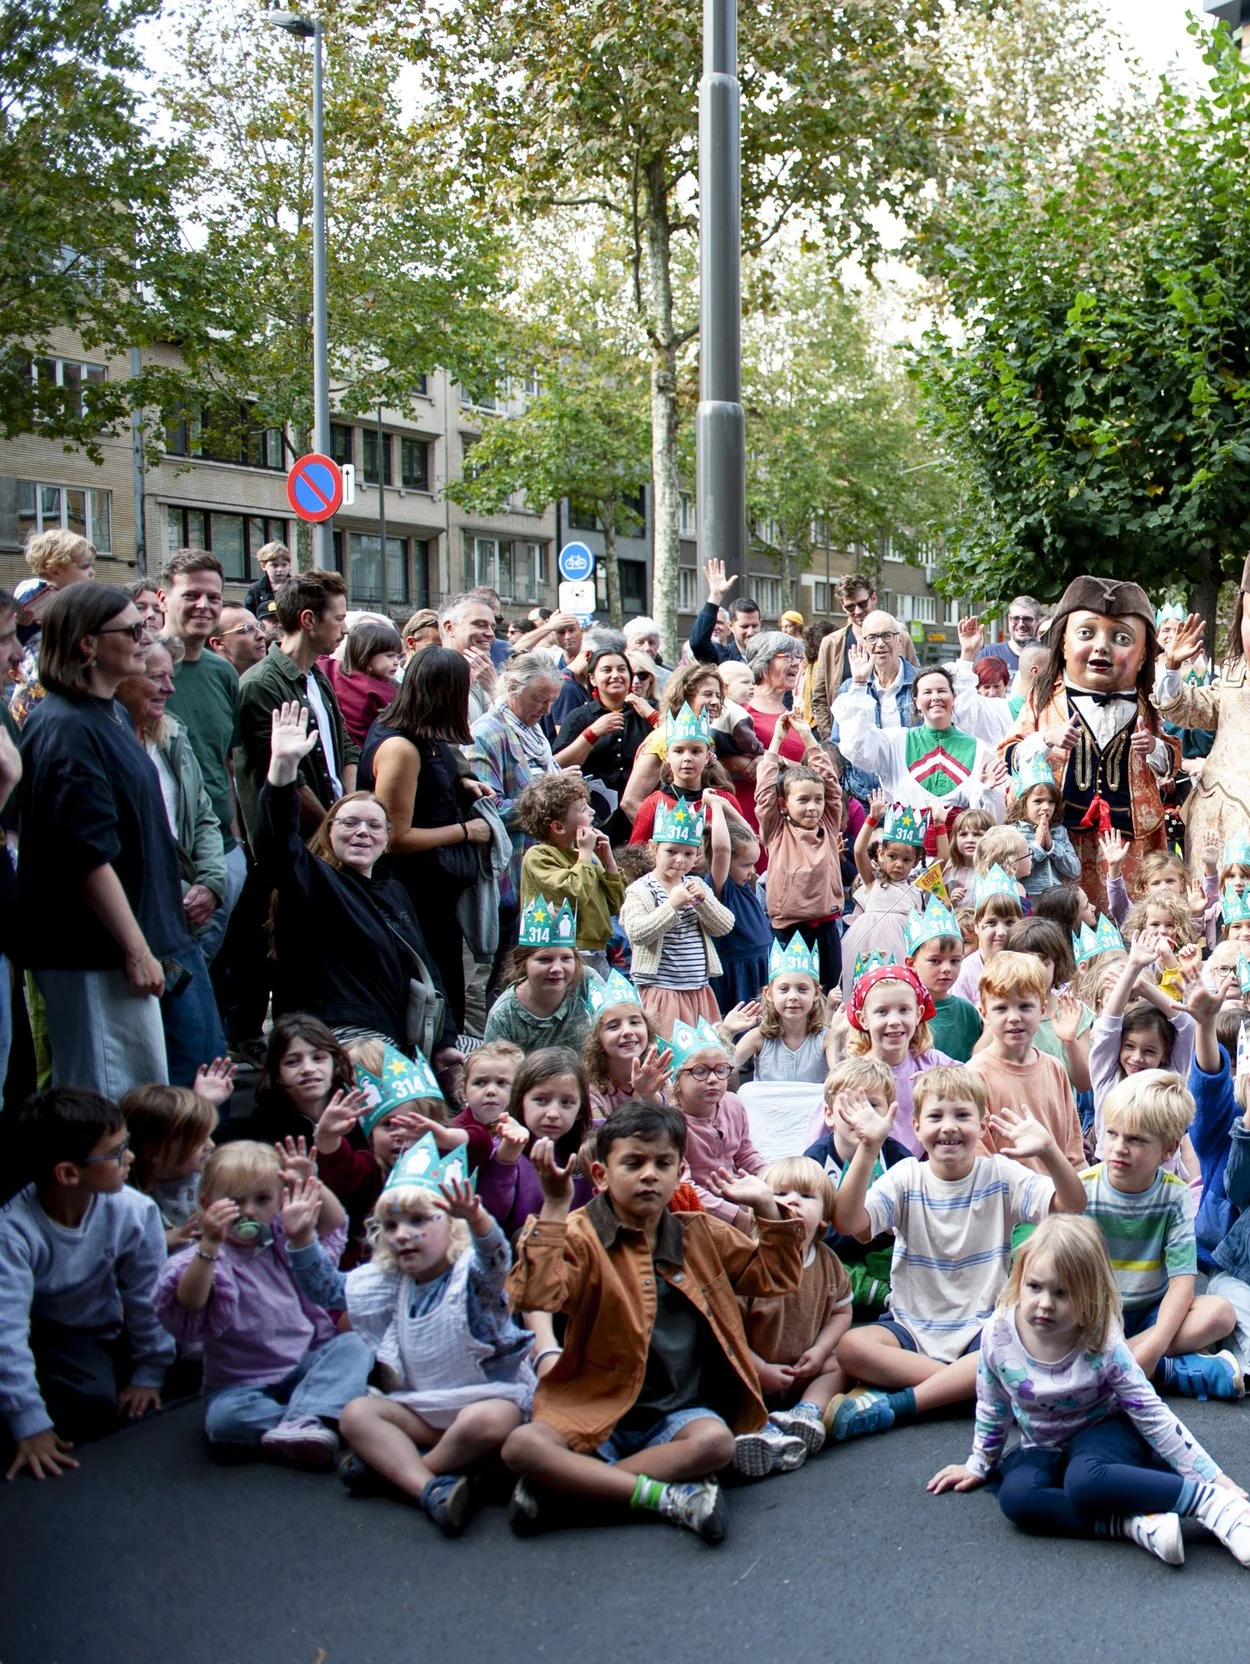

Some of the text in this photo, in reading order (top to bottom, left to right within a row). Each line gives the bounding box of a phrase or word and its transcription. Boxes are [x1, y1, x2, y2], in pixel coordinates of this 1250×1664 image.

[668, 825, 689, 840] 314
[895, 828, 914, 841] 314
[928, 919, 953, 932] 314
[528, 926, 550, 943] 314
[1102, 935, 1121, 949] 314
[788, 956, 809, 971] 314
[612, 989, 635, 1000] 314
[392, 1075, 426, 1098] 314
